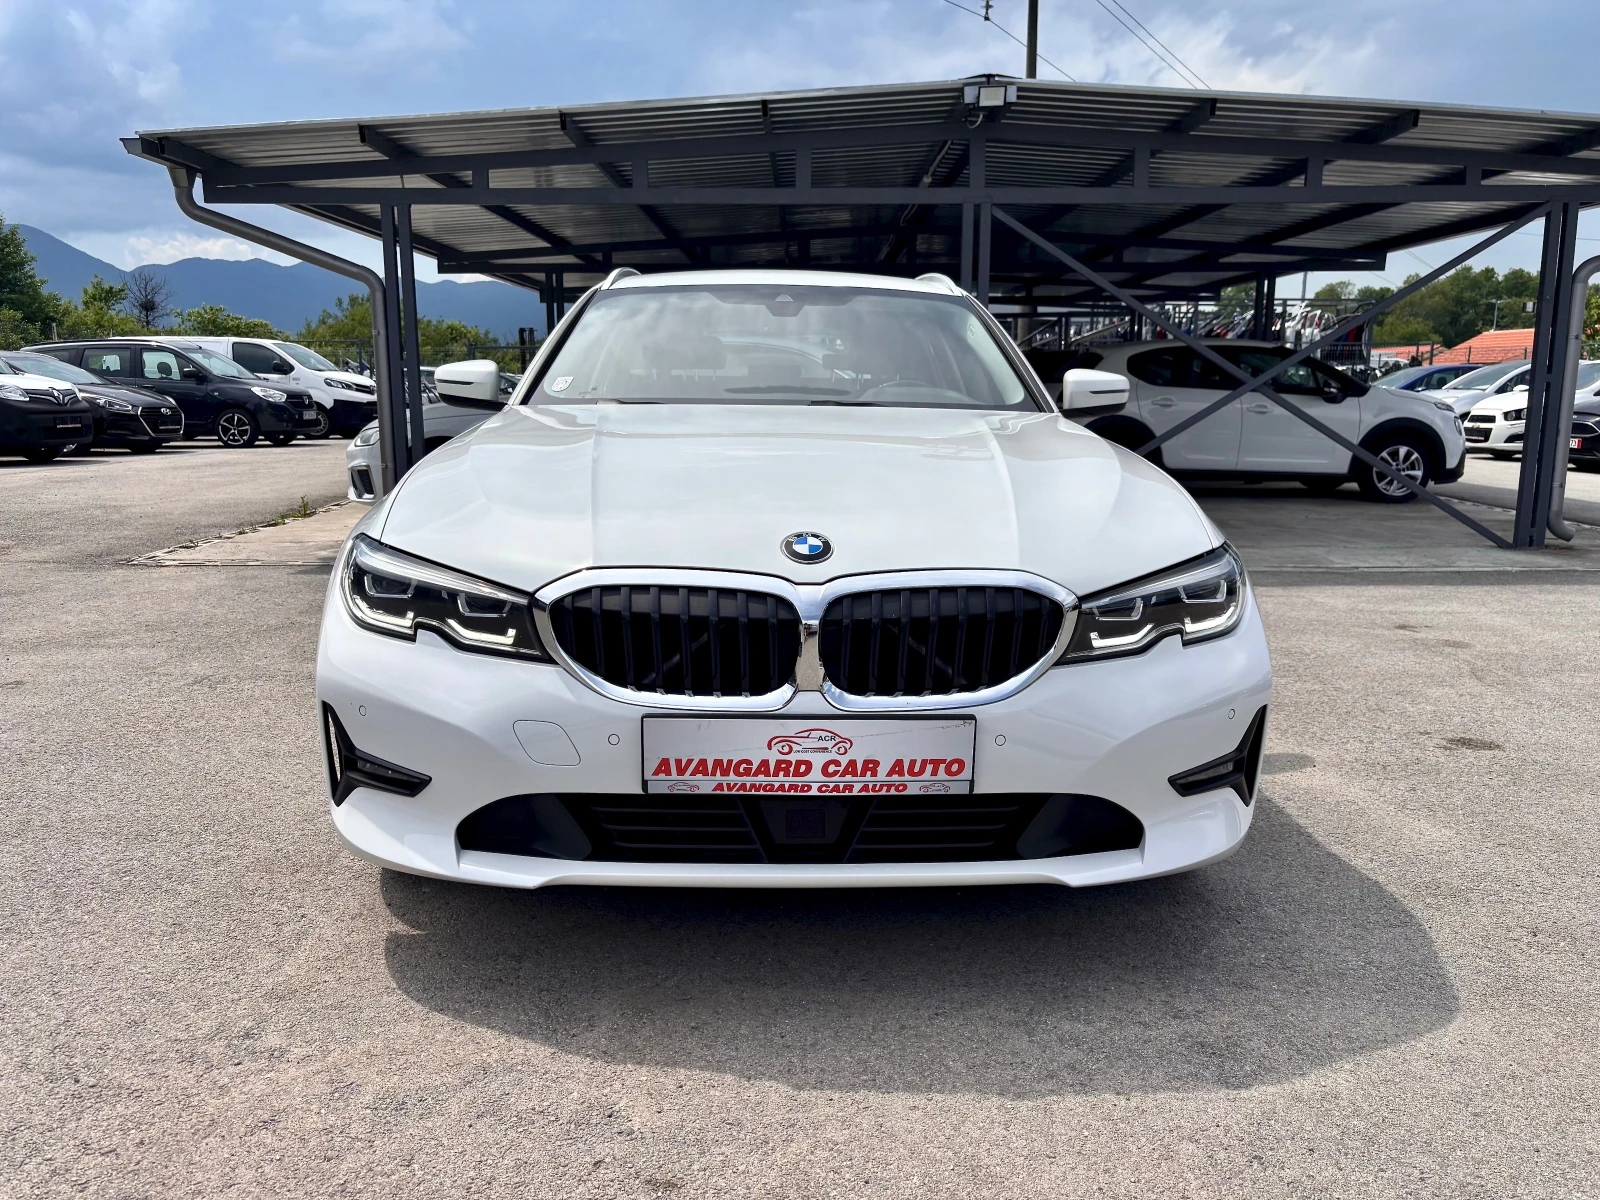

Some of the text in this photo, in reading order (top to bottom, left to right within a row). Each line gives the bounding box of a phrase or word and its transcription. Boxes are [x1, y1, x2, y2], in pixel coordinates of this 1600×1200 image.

[651, 757, 966, 778] AVANGARD CAR AUTO
[711, 782, 908, 794] AVANGARD CAR AUTO
